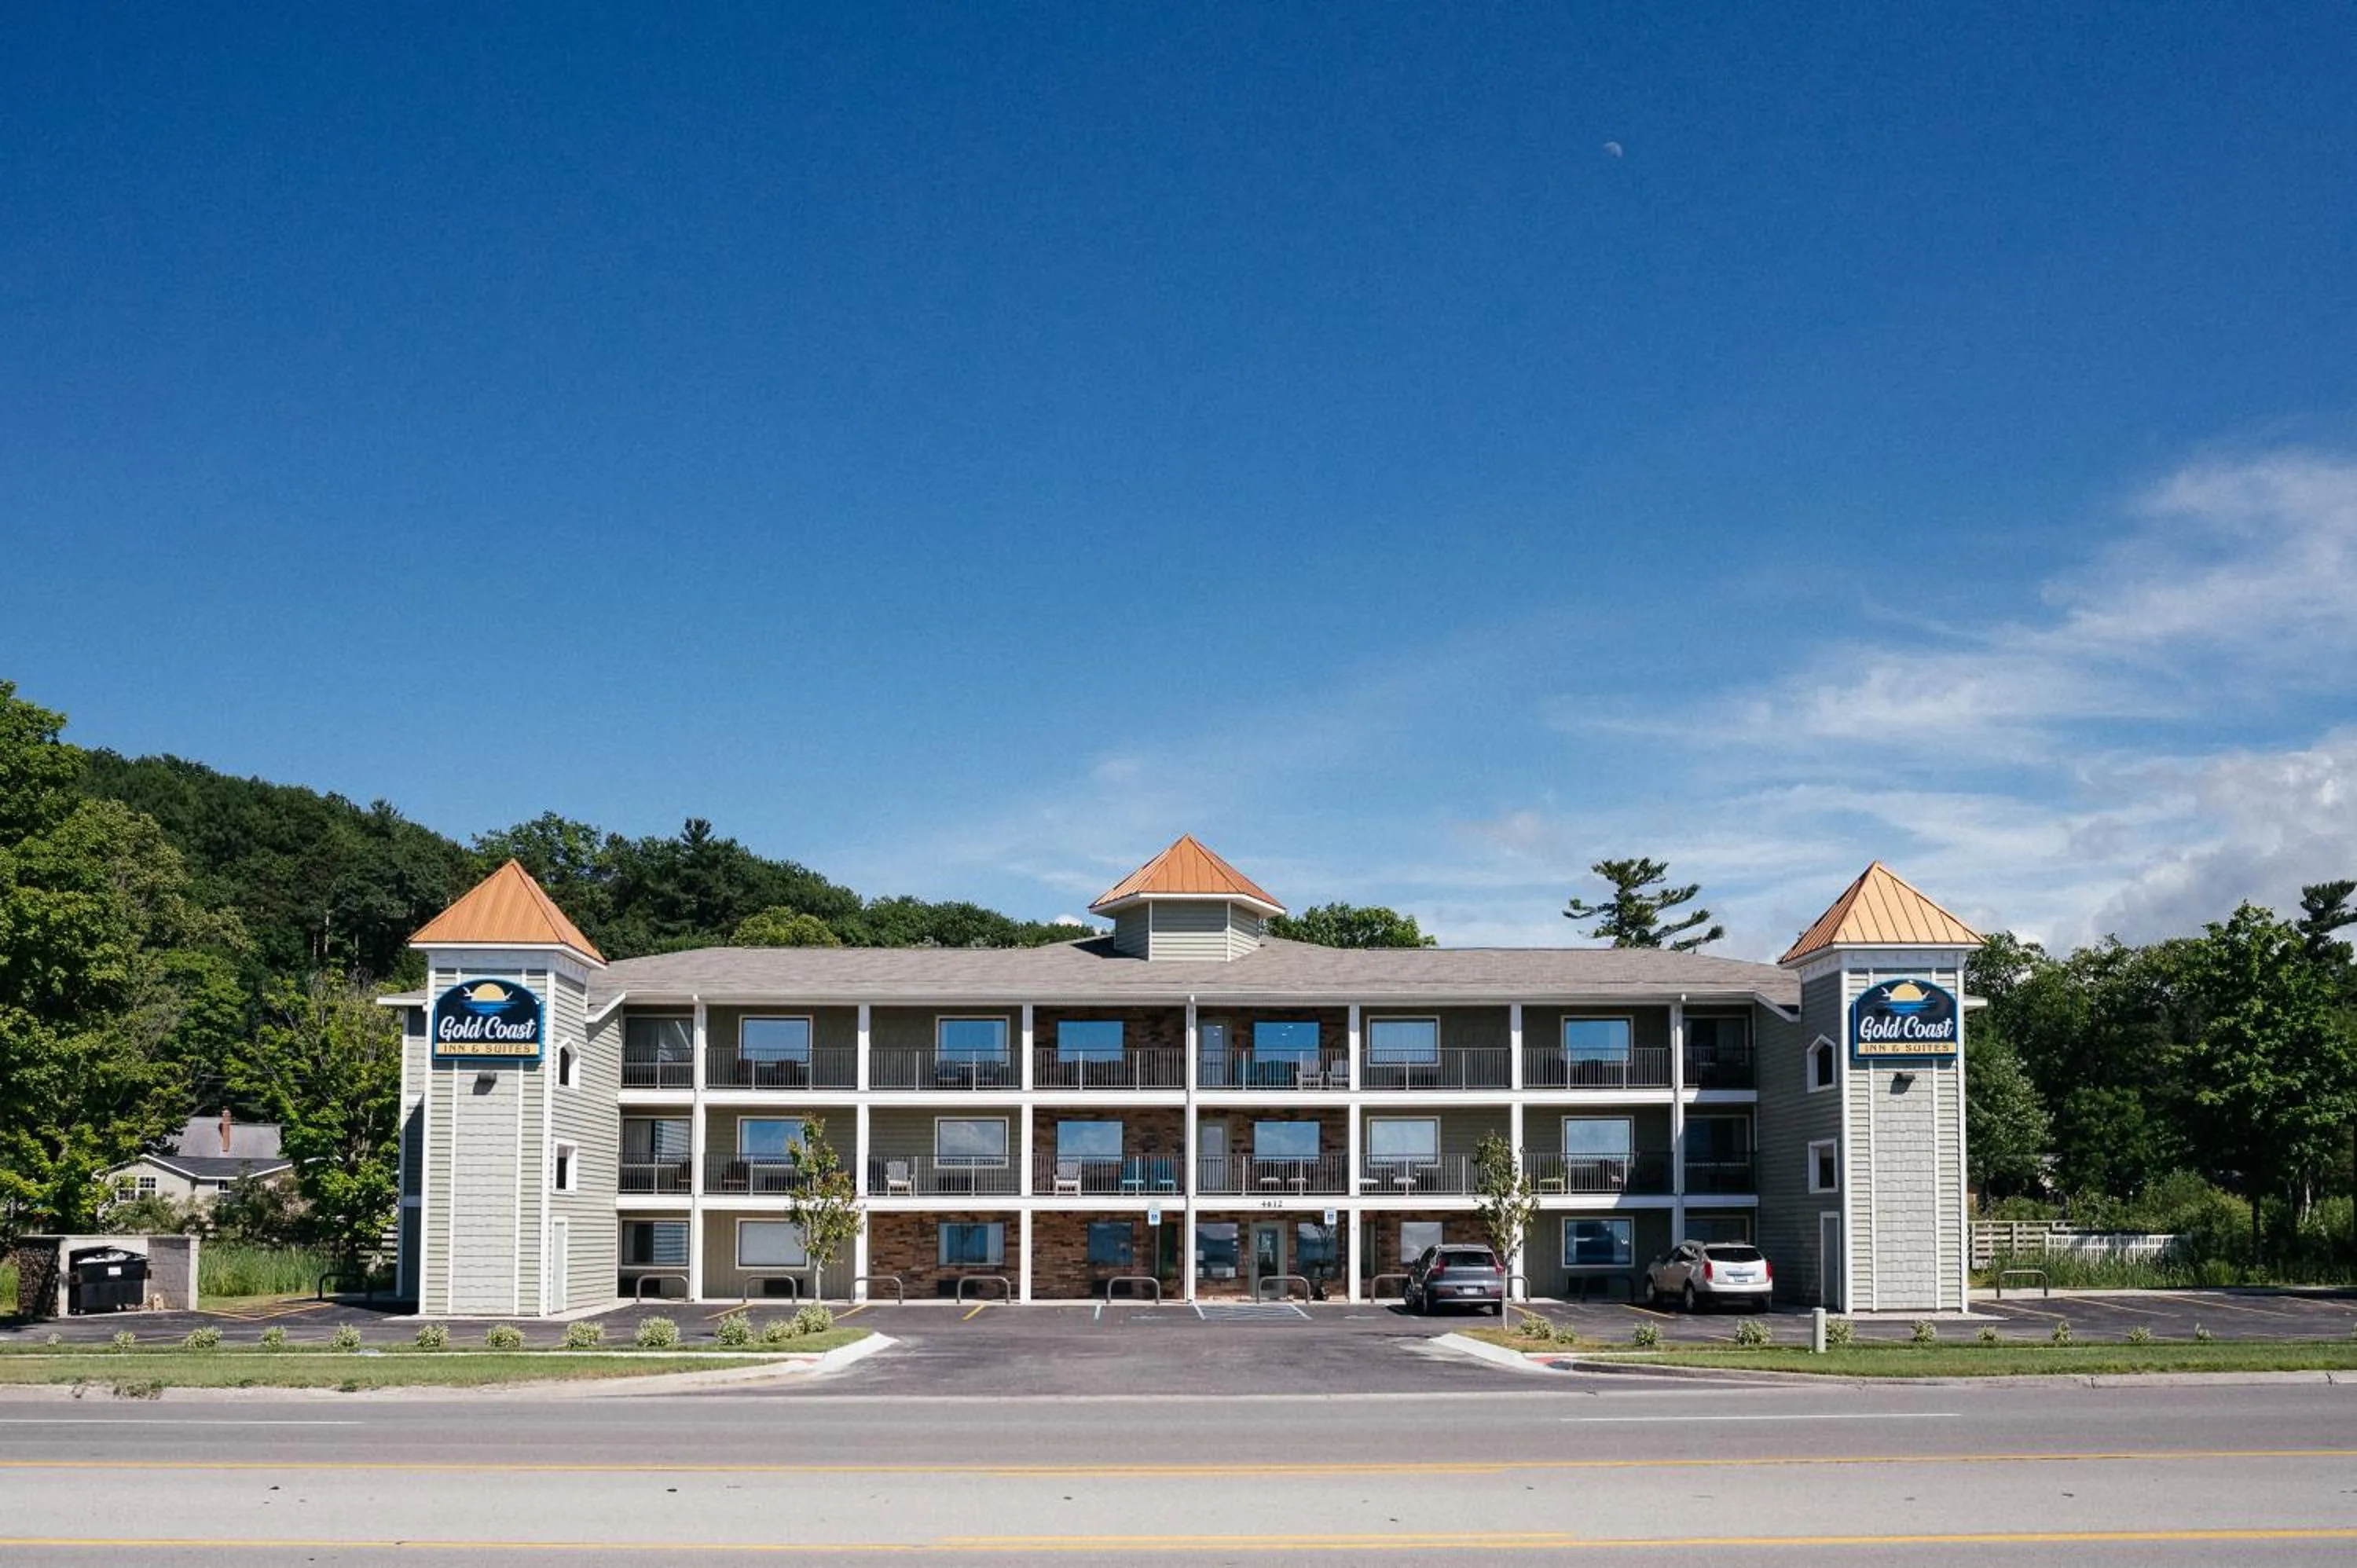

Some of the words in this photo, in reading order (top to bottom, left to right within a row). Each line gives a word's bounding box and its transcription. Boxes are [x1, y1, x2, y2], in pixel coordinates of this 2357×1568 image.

[439, 1016, 484, 1042] Gold
[485, 1016, 536, 1039] Coast
[1860, 1016, 1901, 1042] Gold
[1904, 1016, 1953, 1039] Coast
